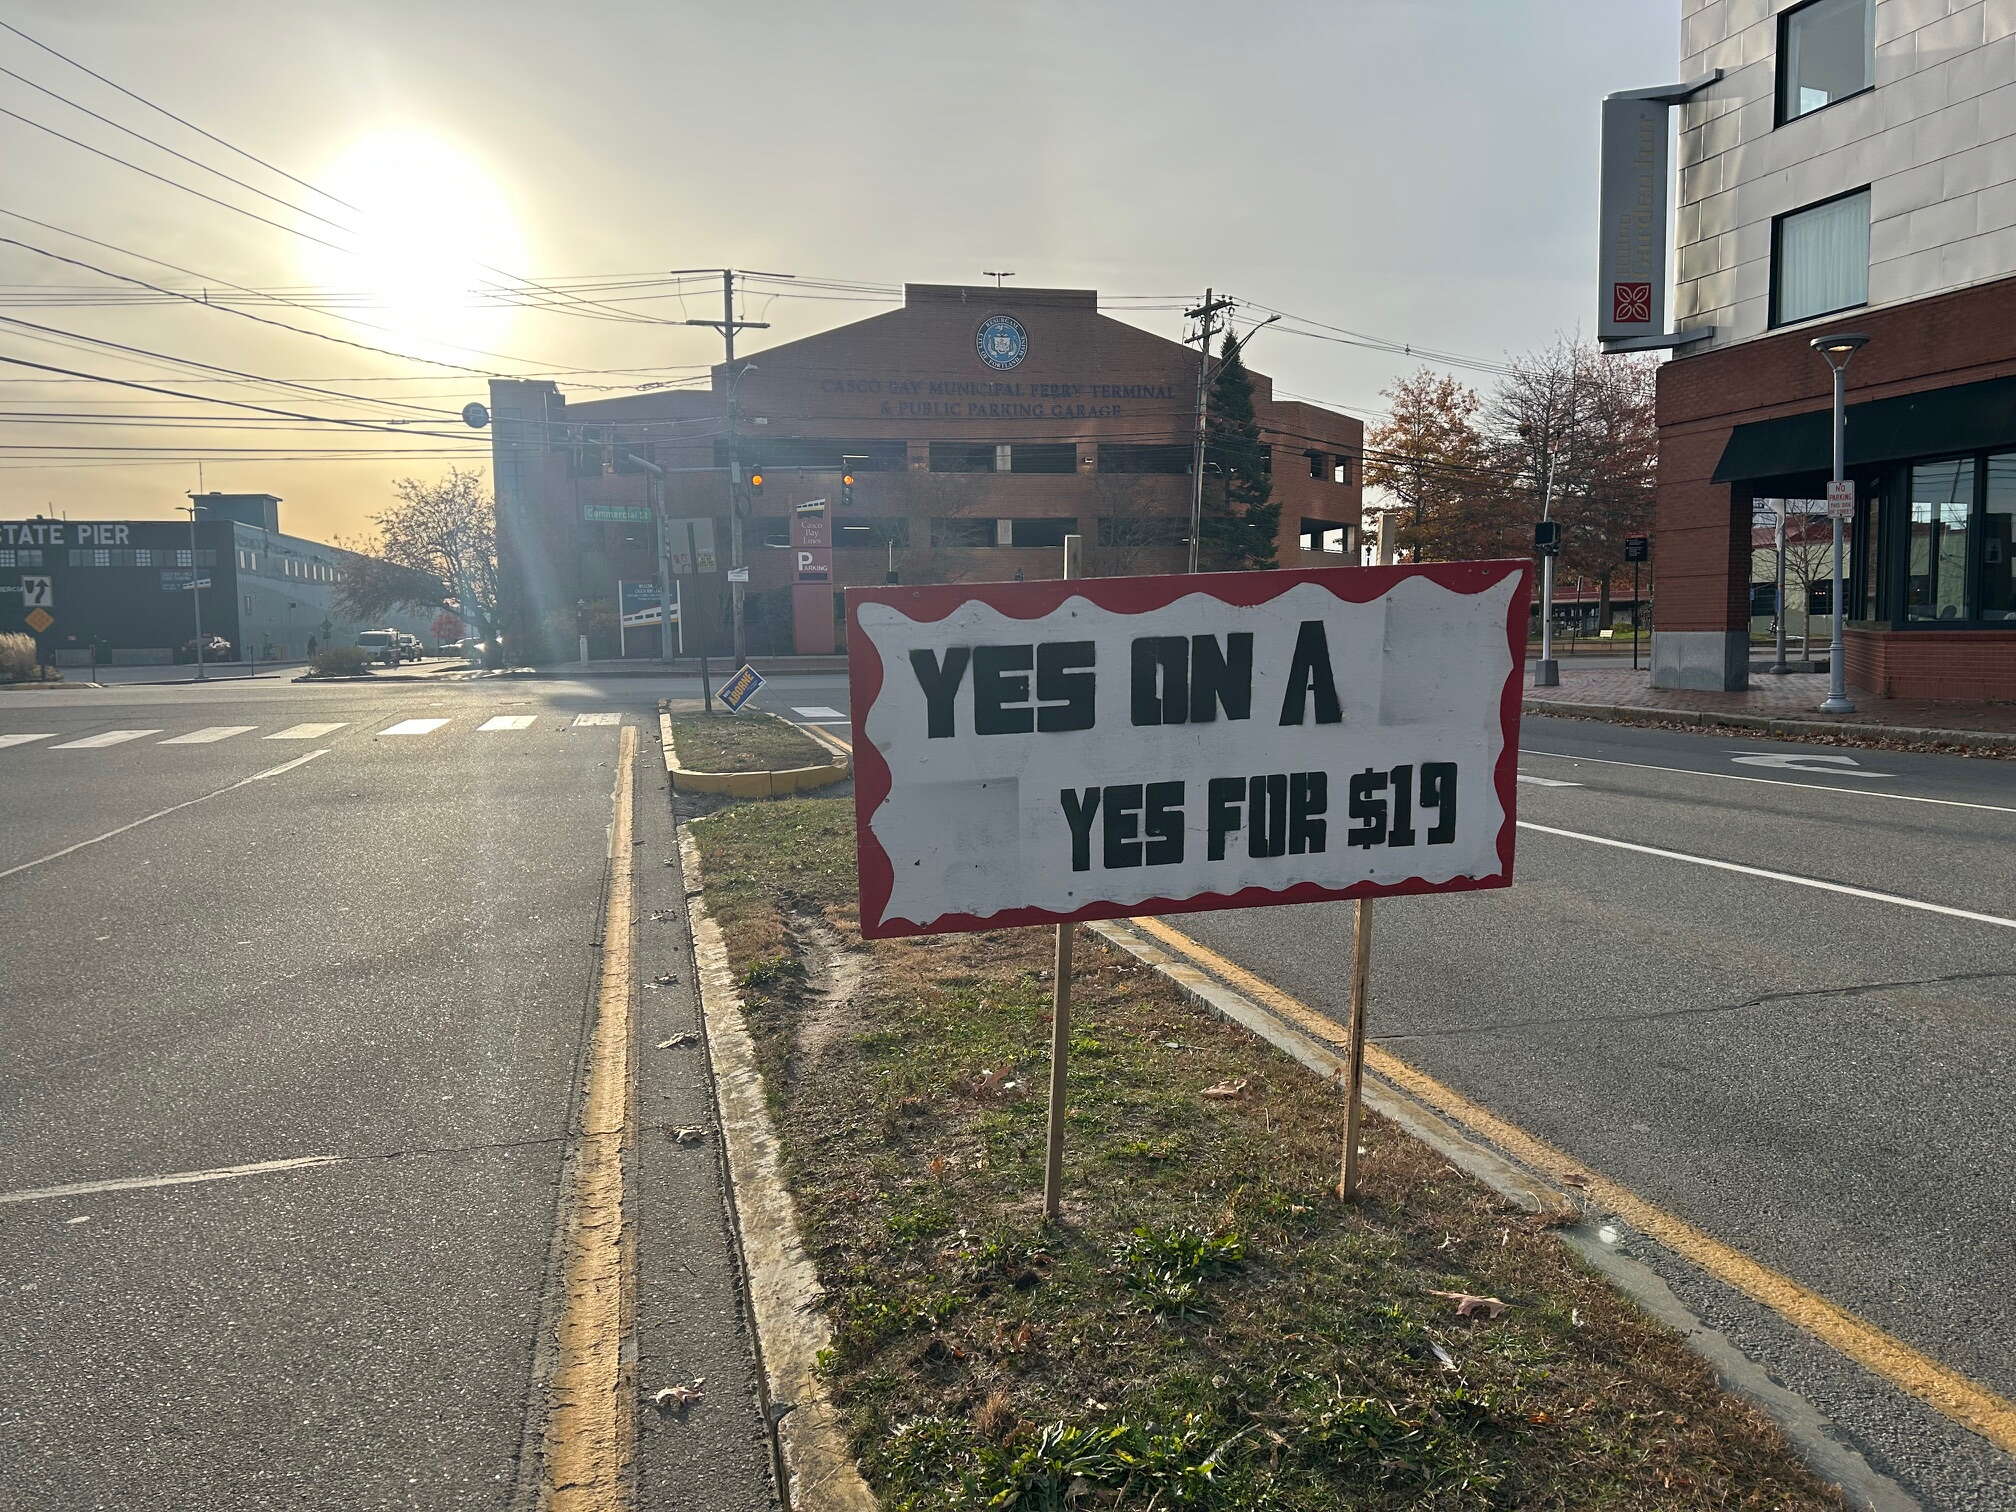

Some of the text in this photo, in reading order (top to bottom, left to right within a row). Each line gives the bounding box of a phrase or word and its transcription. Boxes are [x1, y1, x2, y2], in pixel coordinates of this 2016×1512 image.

[822, 380, 1176, 400] CASCO BAY MUNICIPAL FERRY TERMINAL
[897, 402, 961, 417] PUBLIC
[968, 403, 1044, 418] PARKING
[1052, 404, 1121, 418] GARAGE
[1835, 485, 1846, 493] NO
[801, 520, 823, 529] Casco
[0, 525, 129, 544] TATE PIER
[798, 551, 828, 571] PARKING
[909, 620, 1343, 739] YES ON A
[1061, 762, 1458, 873] YES FOR $19
